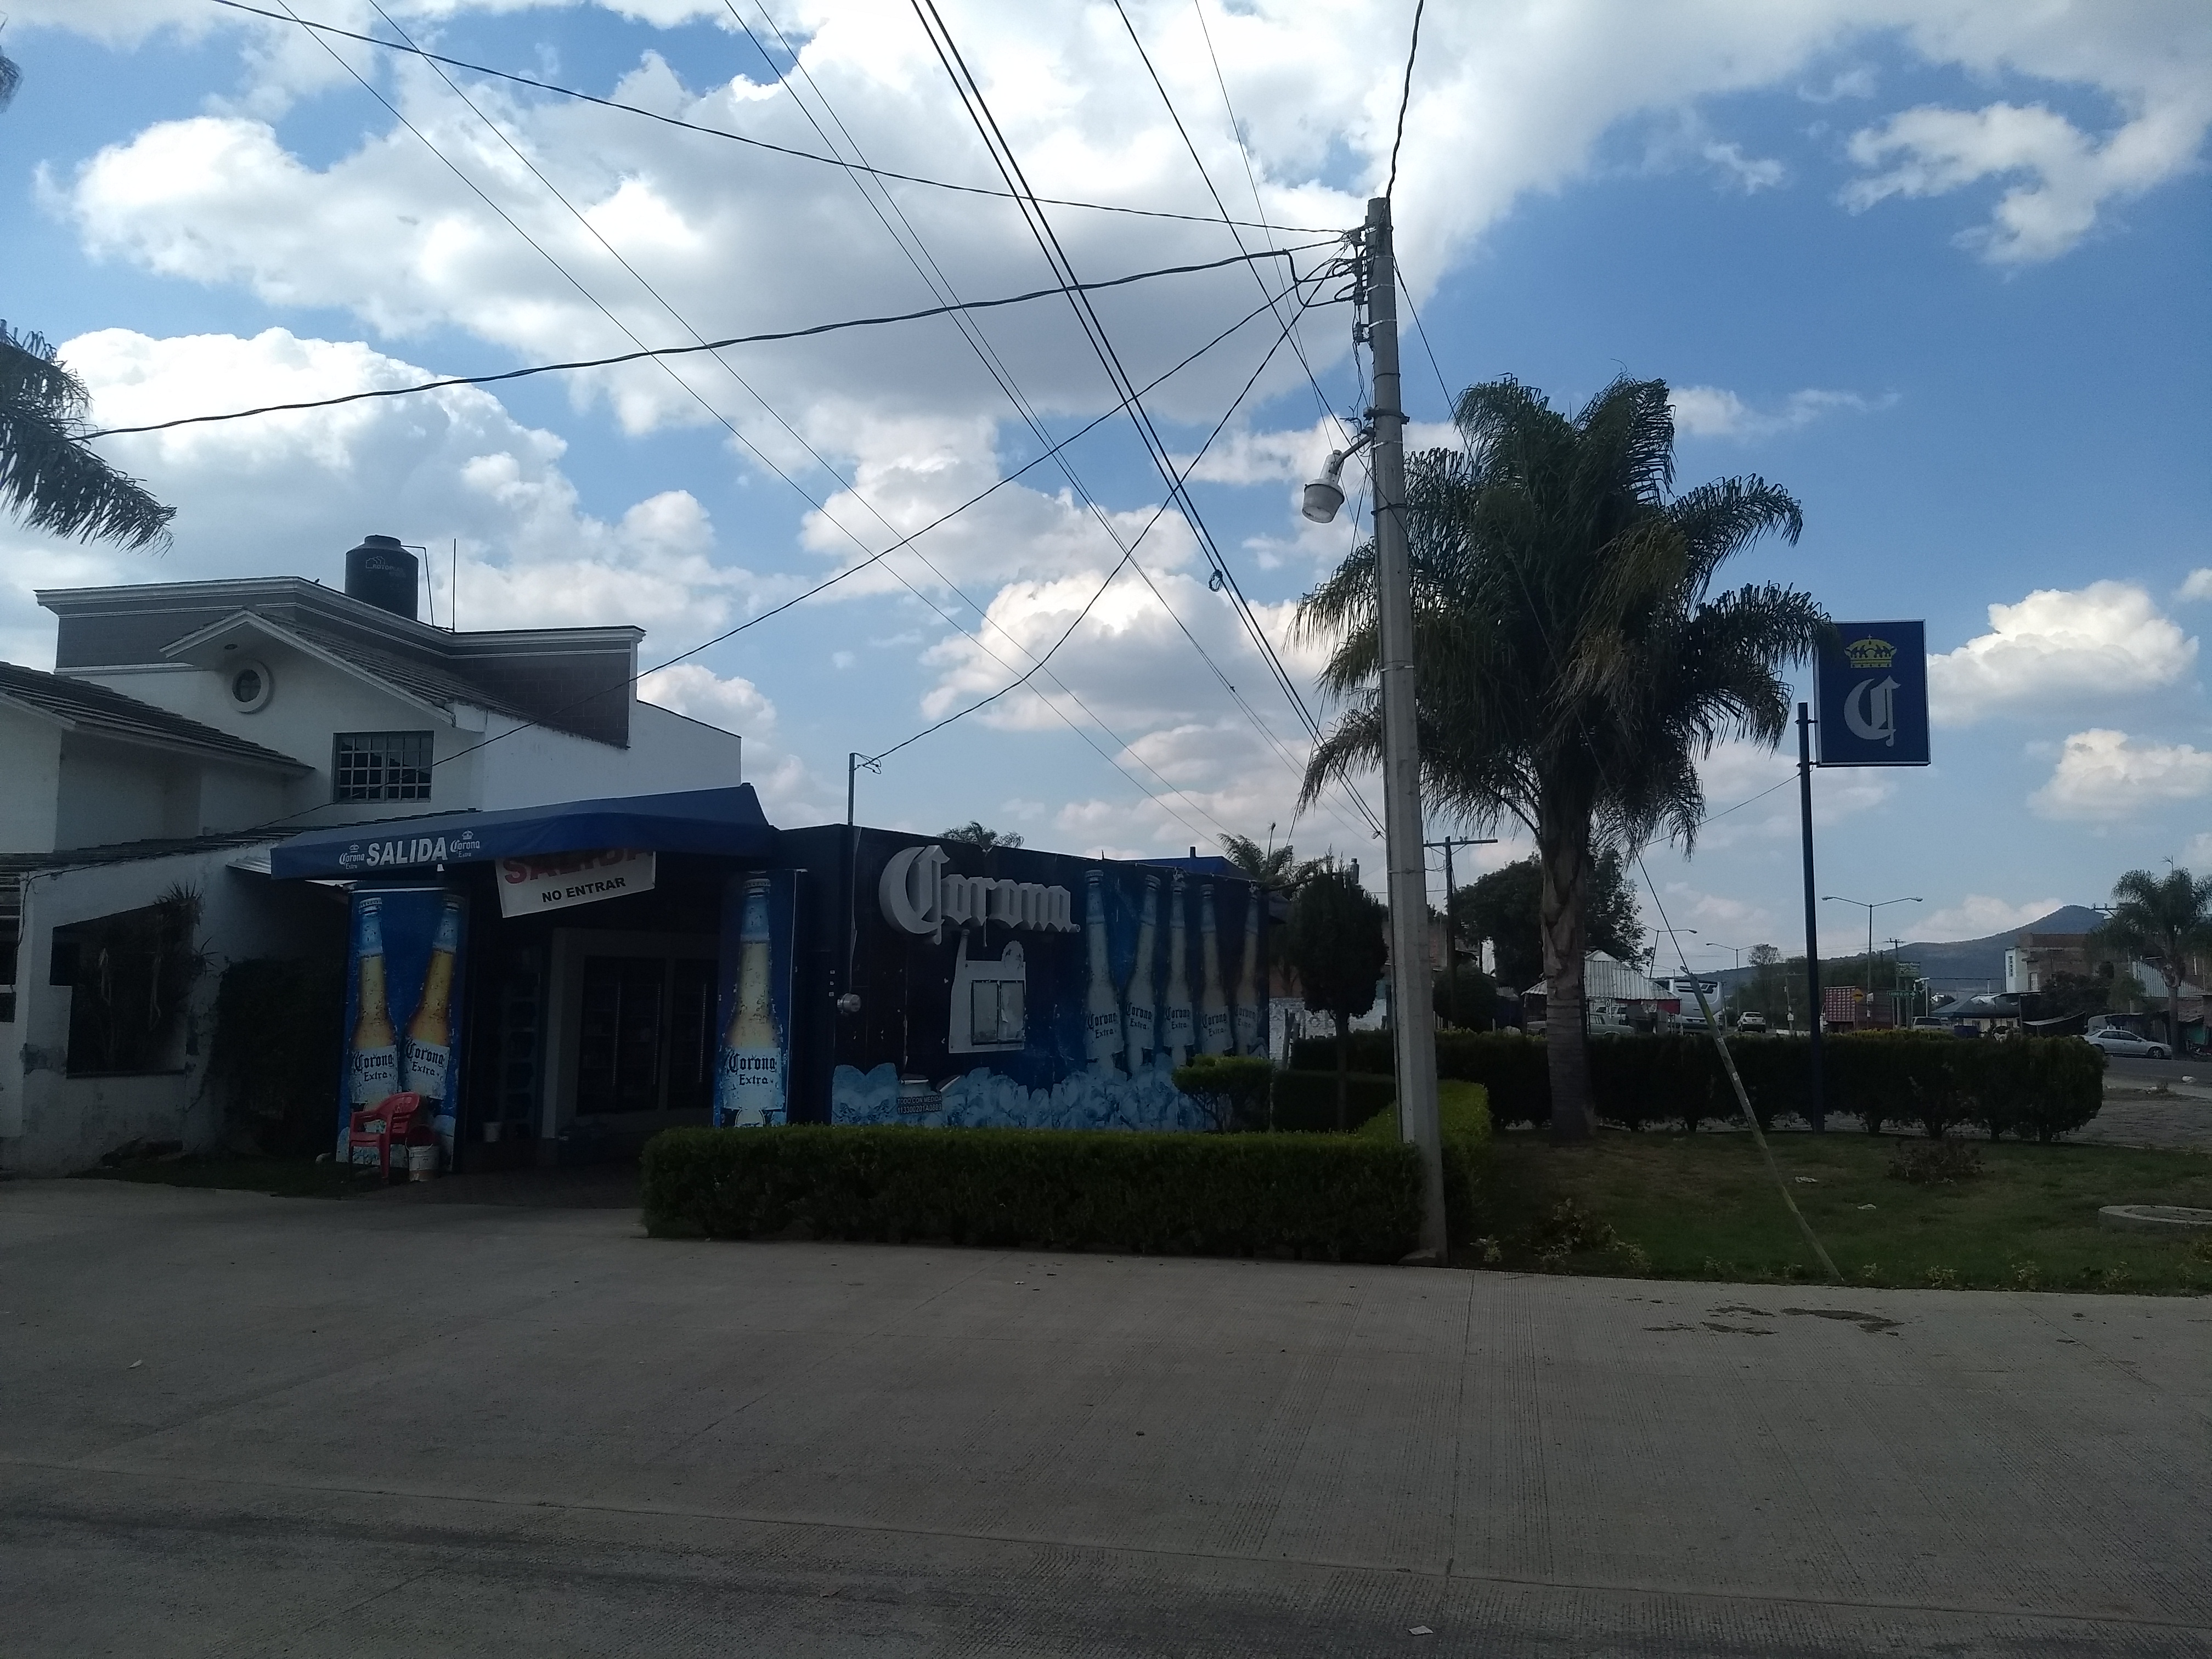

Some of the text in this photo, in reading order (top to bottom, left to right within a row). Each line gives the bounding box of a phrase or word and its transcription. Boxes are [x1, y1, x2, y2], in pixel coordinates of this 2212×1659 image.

[366, 837, 448, 866] SALIDA
[450, 839, 481, 853] Corona
[339, 853, 365, 865] Corona
[541, 877, 625, 902] NO ENTRAR
[879, 844, 1073, 947] Corona
[1126, 1001, 1152, 1020] Corona
[1130, 1018, 1147, 1030] Extra
[1171, 1021, 1187, 1030] Extra
[1095, 1028, 1114, 1039] Extra
[406, 1039, 445, 1067] Corona
[353, 1052, 394, 1074] Corona
[411, 1061, 436, 1076] Extra
[727, 1051, 776, 1075] Corona
[364, 1071, 388, 1082] Extra
[739, 1074, 769, 1086] Extra
